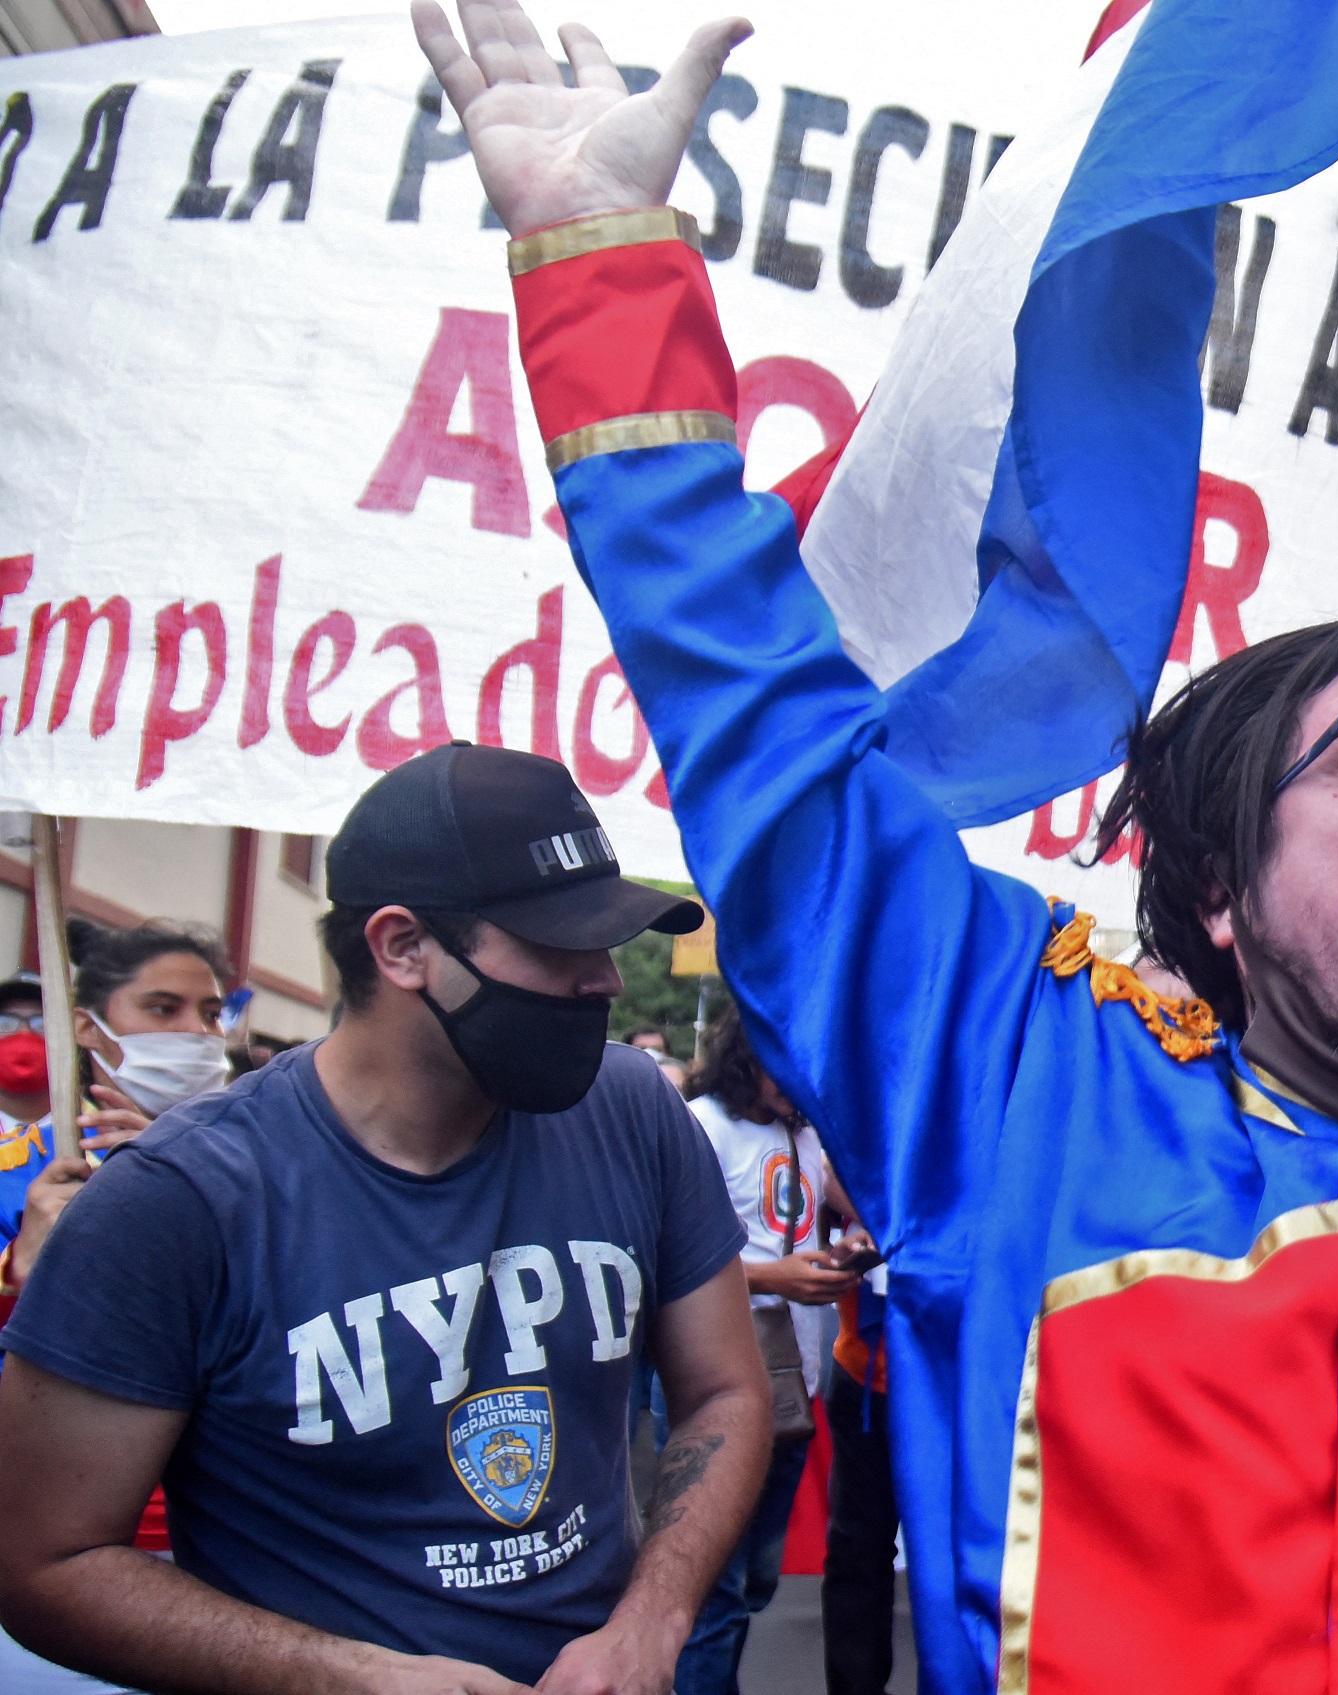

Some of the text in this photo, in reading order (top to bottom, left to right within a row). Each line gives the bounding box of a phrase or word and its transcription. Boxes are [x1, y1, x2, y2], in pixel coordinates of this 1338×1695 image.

[32, 82, 140, 244] A
[166, 58, 344, 221] LA
[287, 1240, 642, 1445] NYPD
[451, 1409, 550, 1447] DEPARTMENT
[467, 1393, 527, 1418] POLICE
[457, 1457, 503, 1511] CITY OF
[522, 1432, 553, 1511] NEW YORK
[424, 1503, 588, 1568] NEW YORK CITY
[439, 1533, 590, 1588] POLICE DEPT.
